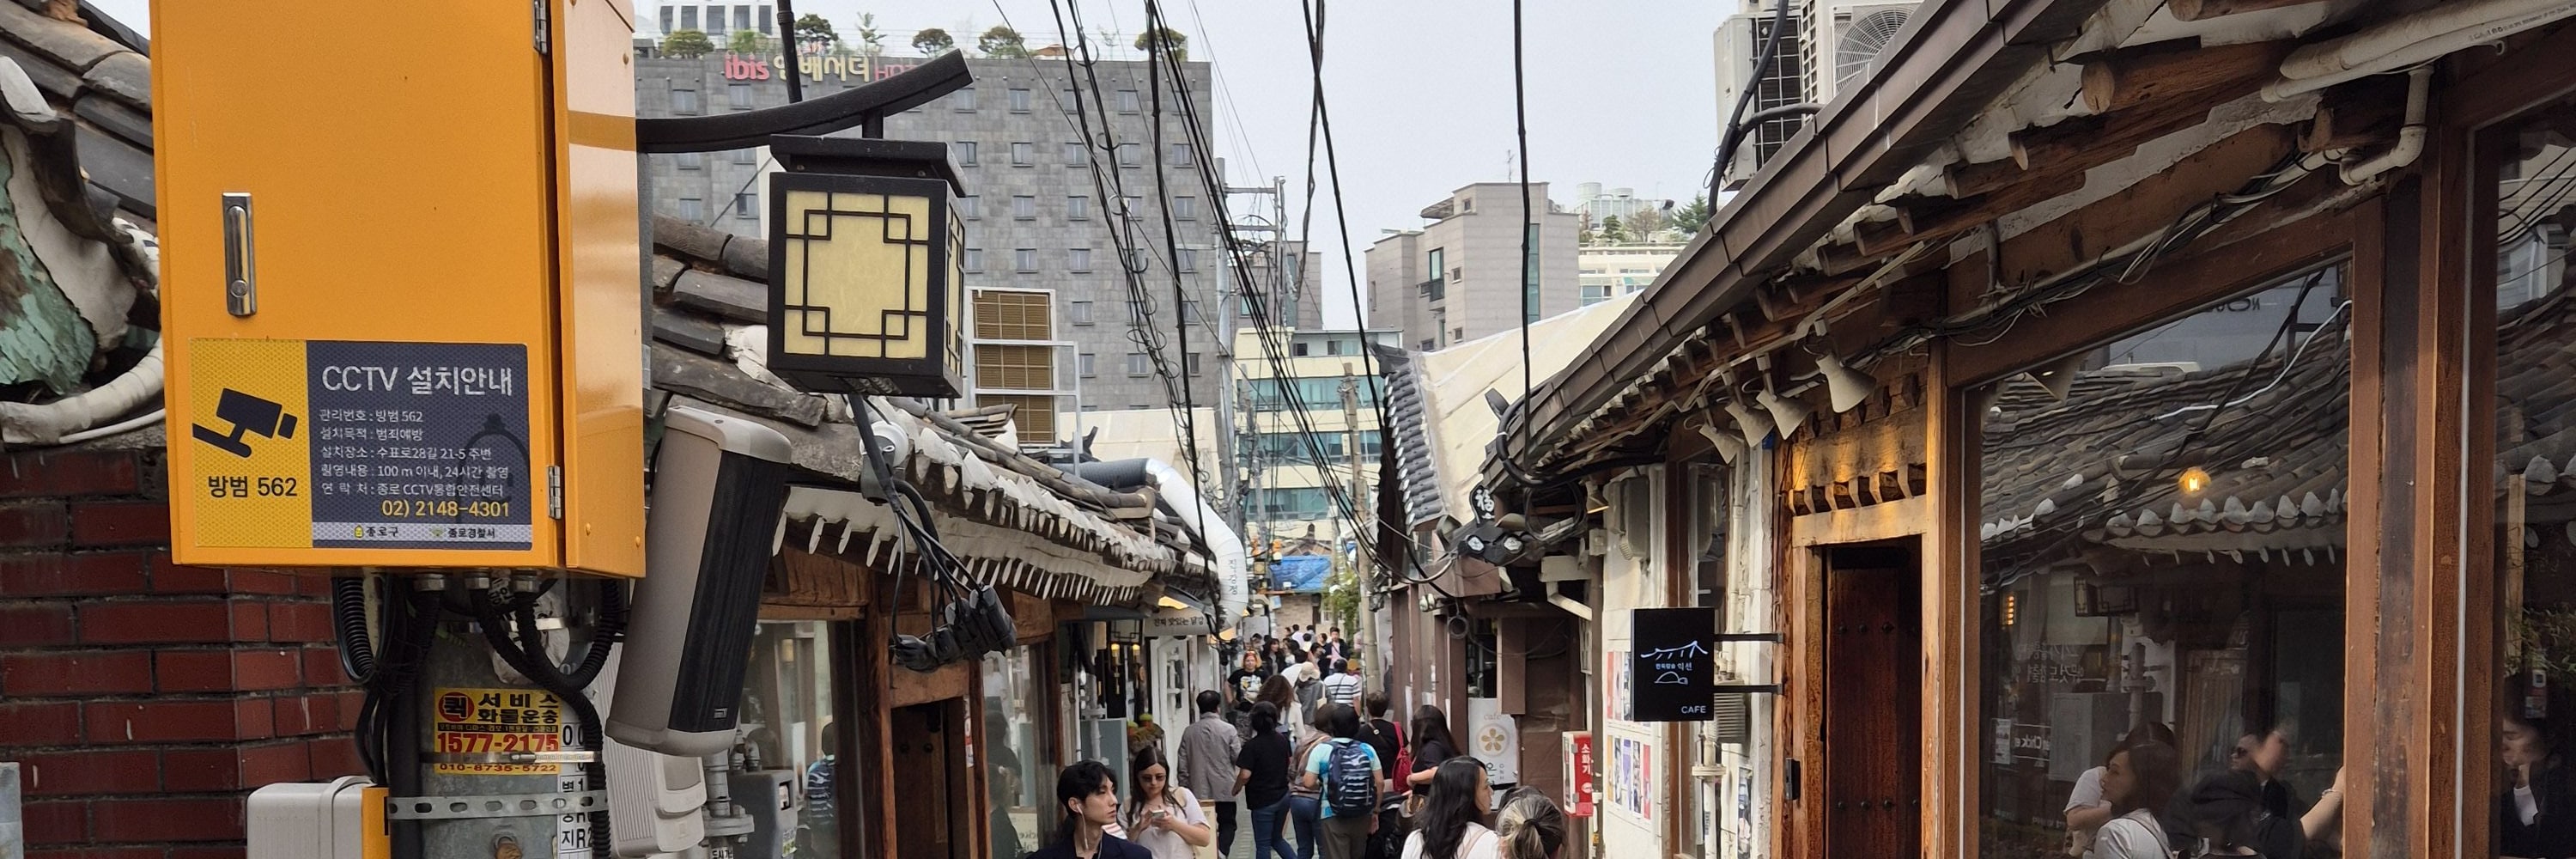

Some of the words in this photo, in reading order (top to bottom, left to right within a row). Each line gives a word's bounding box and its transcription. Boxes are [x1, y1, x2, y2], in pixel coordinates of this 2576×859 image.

[725, 54, 769, 80] ibis
[322, 366, 398, 391] CCTV
[407, 367, 512, 396] 설치안내
[375, 410, 398, 423] 방범
[401, 411, 423, 423] 562
[376, 428, 423, 442] 범죄예방
[377, 447, 437, 460] 수표로28길
[440, 448, 466, 460] 21-5
[469, 448, 492, 460] 주변
[378, 466, 398, 477] 100
[401, 467, 413, 477] m
[445, 466, 483, 478] 24시간
[486, 466, 508, 478] 촬영
[208, 476, 248, 497] 방범
[258, 477, 297, 497] 562
[378, 483, 401, 496] 종로
[382, 499, 410, 517] 02)
[415, 500, 509, 517] 2148-4301
[366, 526, 399, 538] 종로구
[447, 527, 495, 539] 종로경찰서
[444, 696, 468, 718] 퀵
[1680, 705, 1706, 714] CAFE
[477, 709, 558, 723] 화물운송
[437, 733, 558, 752] 1577-2175
[440, 763, 556, 772] 010-8735-5722
